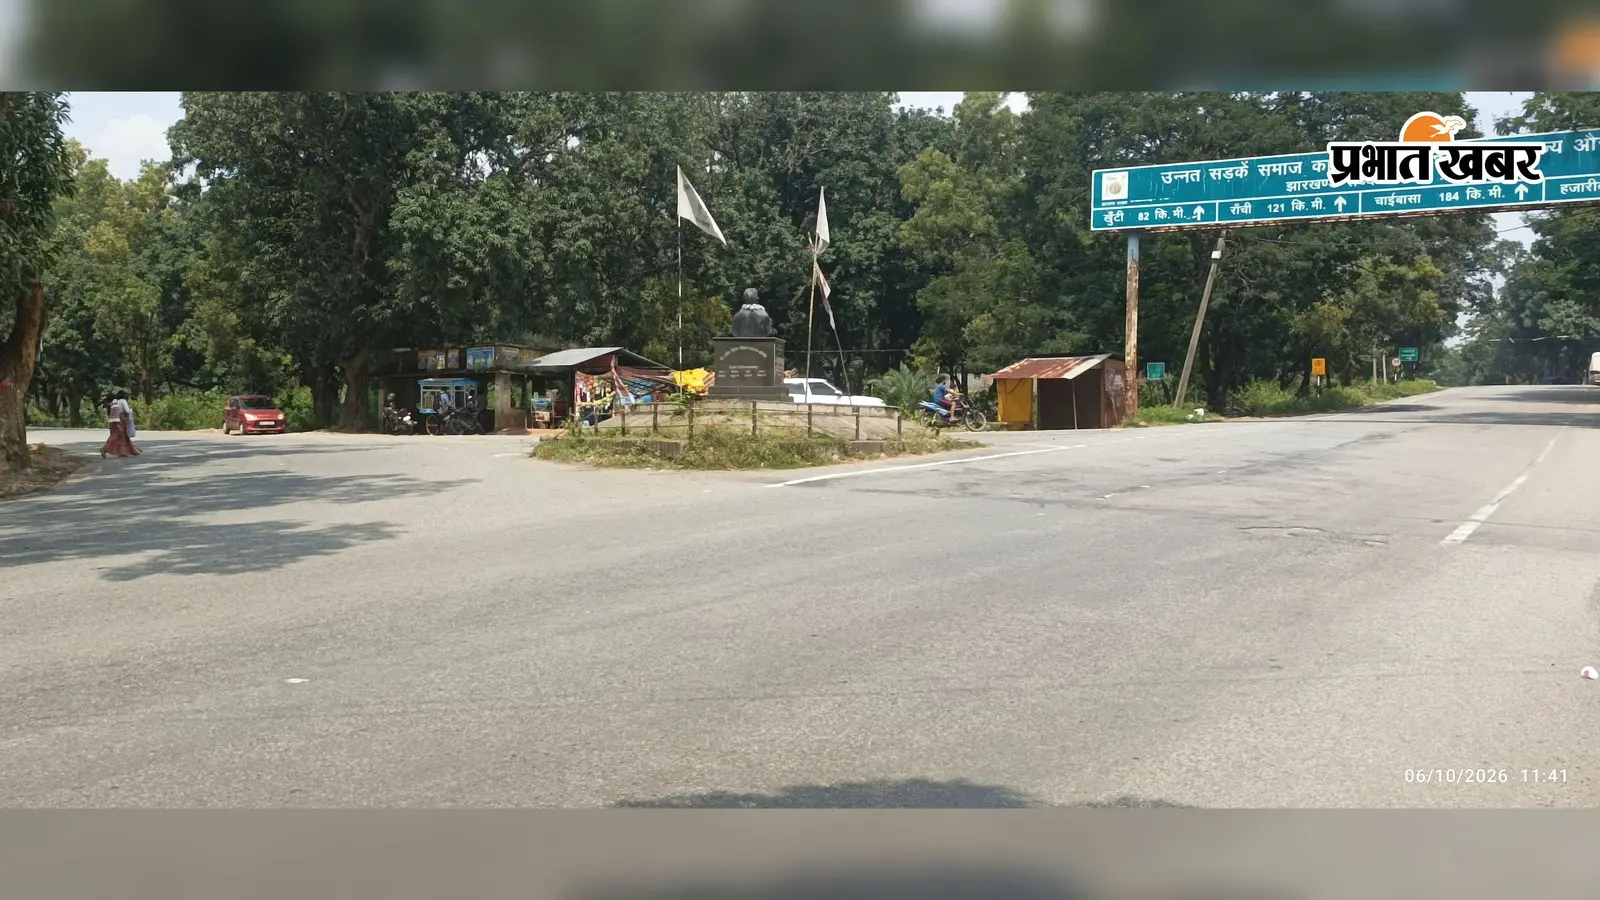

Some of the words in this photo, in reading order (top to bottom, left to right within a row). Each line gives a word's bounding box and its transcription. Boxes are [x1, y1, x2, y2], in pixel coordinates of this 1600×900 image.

[1160, 170, 1201, 184] उन्नत
[1208, 160, 1249, 183] सड़कें
[1257, 161, 1303, 177] समाज
[1311, 159, 1329, 173] क
[1573, 132, 1600, 152] औ
[1286, 178, 1332, 193] झारखण्
[1560, 178, 1600, 195] हजारी
[1374, 192, 1421, 207] चाईबासा
[1439, 192, 1459, 202] 184
[1230, 201, 1252, 215] राँची
[1267, 203, 1285, 213] 121
[1137, 212, 1149, 221] 82
